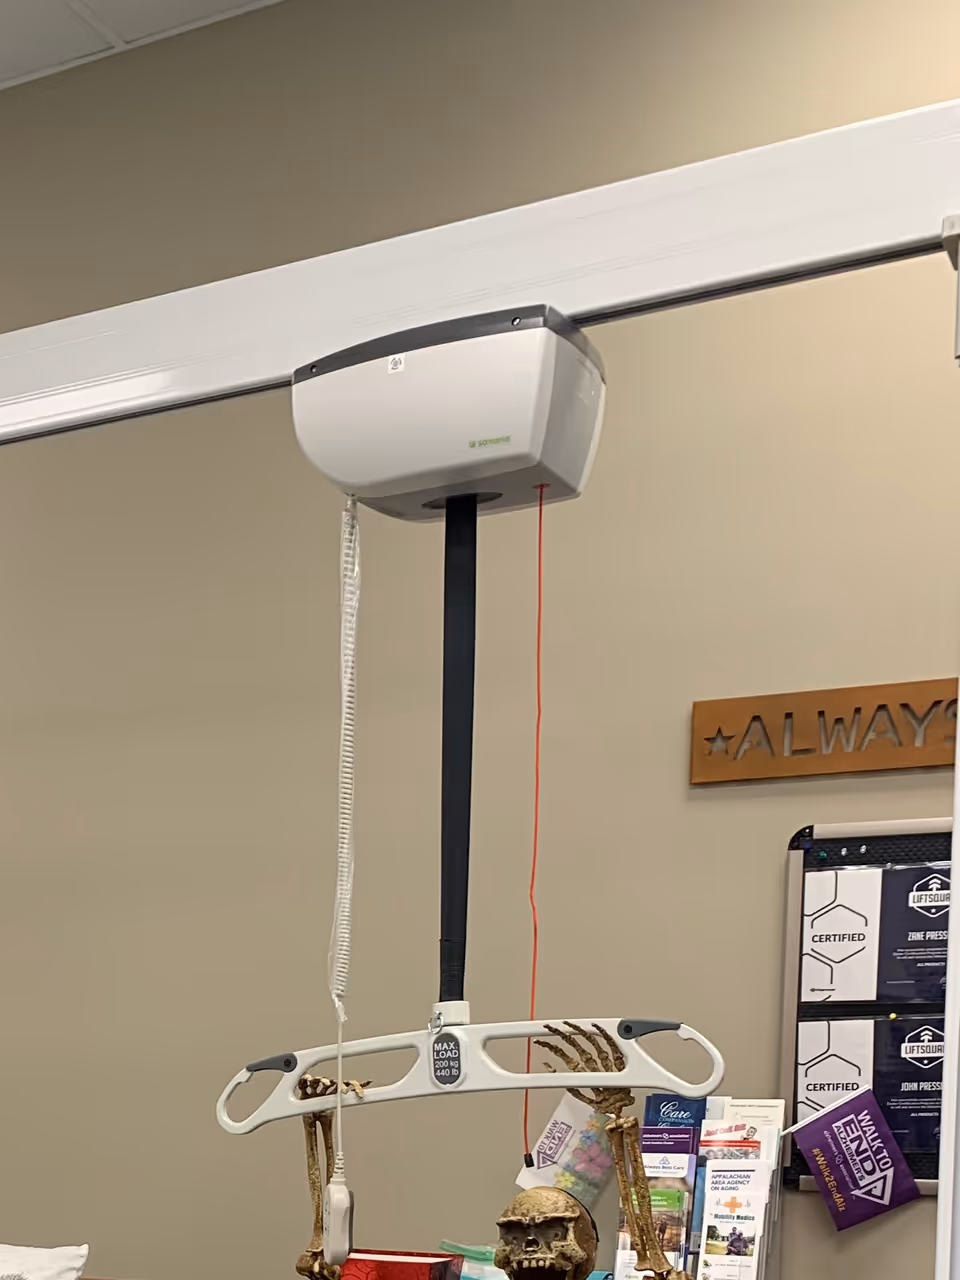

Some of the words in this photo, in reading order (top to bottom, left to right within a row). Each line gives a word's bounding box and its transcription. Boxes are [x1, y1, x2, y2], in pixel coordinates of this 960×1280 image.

[811, 932, 866, 943] CERTIFIED
[434, 1042, 458, 1051] MAX.
[434, 1050, 458, 1059] LOAD
[450, 1060, 458, 1068] kg
[451, 1068, 458, 1076] lb
[806, 1082, 860, 1092] CERTIFIED
[900, 1082, 918, 1091] JOHN
[660, 1101, 691, 1119] Care
[857, 1109, 884, 1151] WALK
[876, 1149, 892, 1171] TO
[842, 1117, 877, 1176] END
[834, 1125, 865, 1181] ALZHEIMER'S
[812, 1148, 846, 1212] #Walk2EndAlz
[713, 1213, 735, 1221] Mobility
